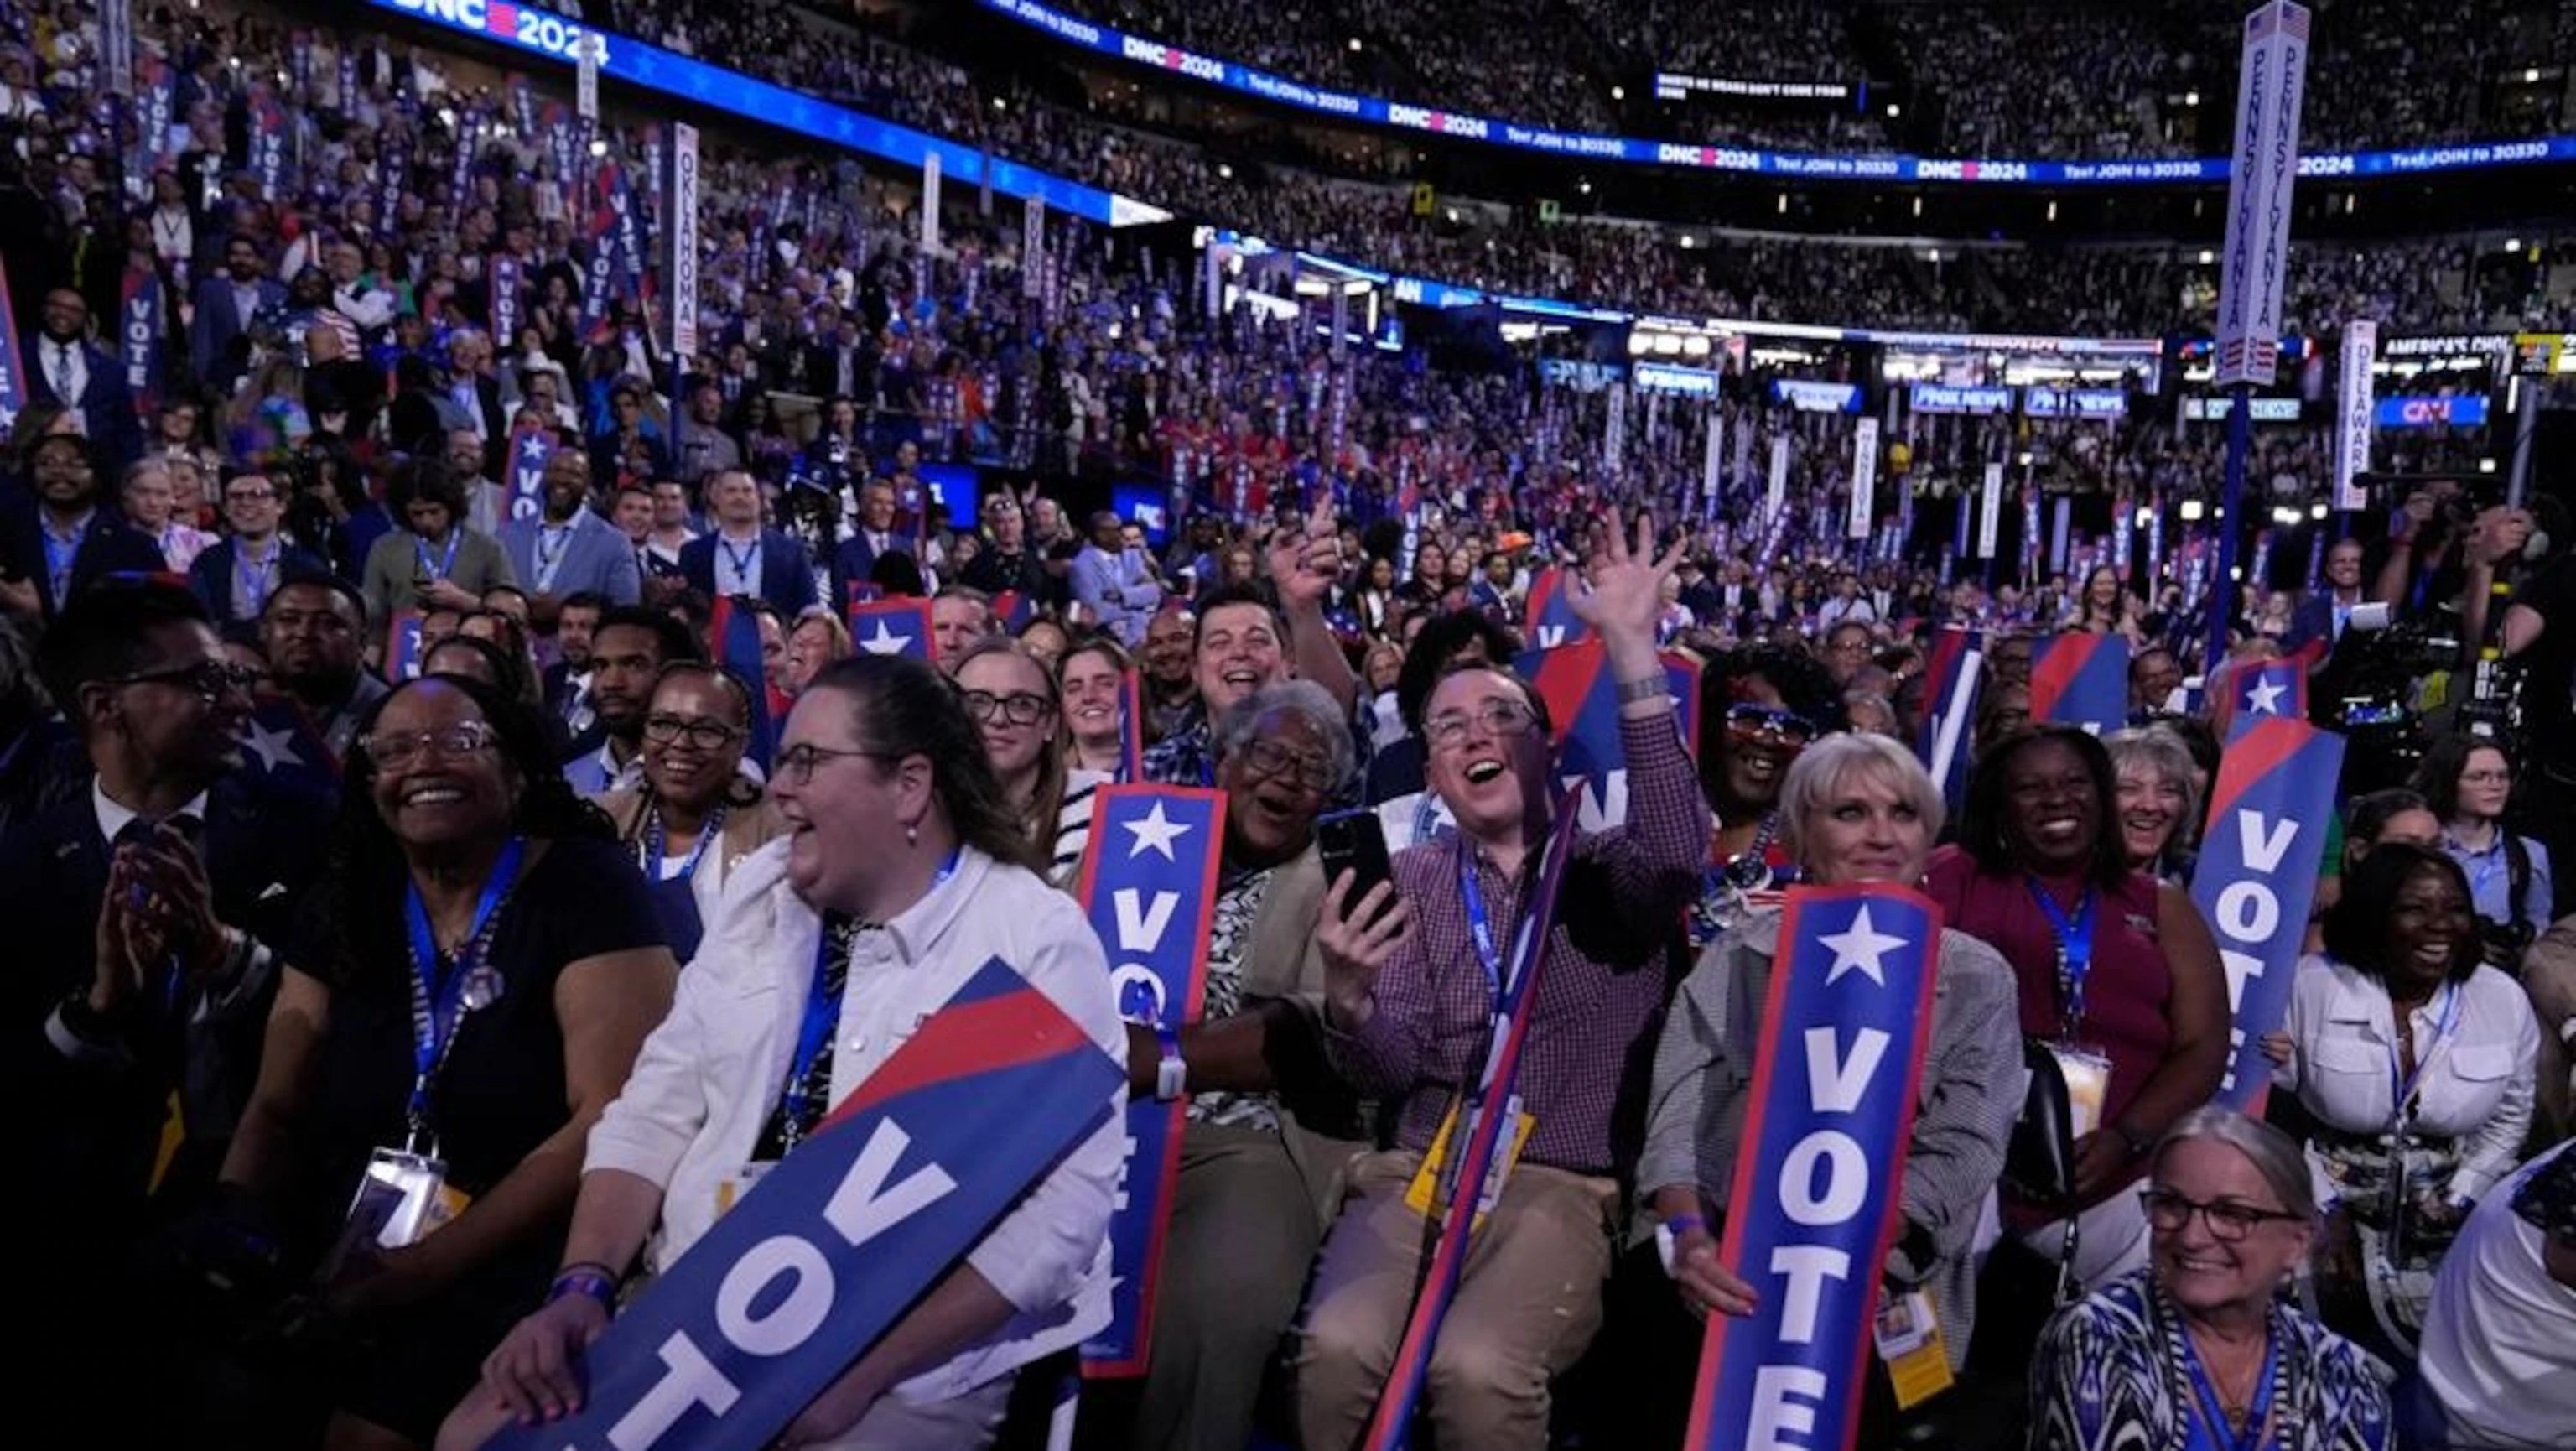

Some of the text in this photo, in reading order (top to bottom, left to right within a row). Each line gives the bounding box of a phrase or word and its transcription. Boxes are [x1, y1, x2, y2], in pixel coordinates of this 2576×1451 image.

[1123, 35, 1224, 82] DNC 2024
[149, 86, 168, 153] VOTE
[1389, 101, 1488, 138] DNC 2024
[263, 134, 281, 200] VOTE
[1659, 143, 1761, 169] DNC 2024
[1917, 159, 2028, 181] DNC 2024
[2096, 164, 2133, 179] JOIN
[2153, 161, 2202, 177] 30330
[2259, 46, 2296, 327] PENNSYLVANIA
[2295, 155, 2355, 176] 2024
[2431, 148, 2470, 166] JOIN
[2492, 142, 2550, 161] 30330
[2228, 49, 2265, 329] PENNSYLVANIA
[680, 153, 694, 322] OKLAHOMA
[588, 237, 613, 317] VOTE
[128, 298, 152, 387] VOTE
[2351, 344, 2371, 472] DELAWAR
[1746, 1027, 1890, 1451] VOTE
[560, 1116, 958, 1451] VOT
